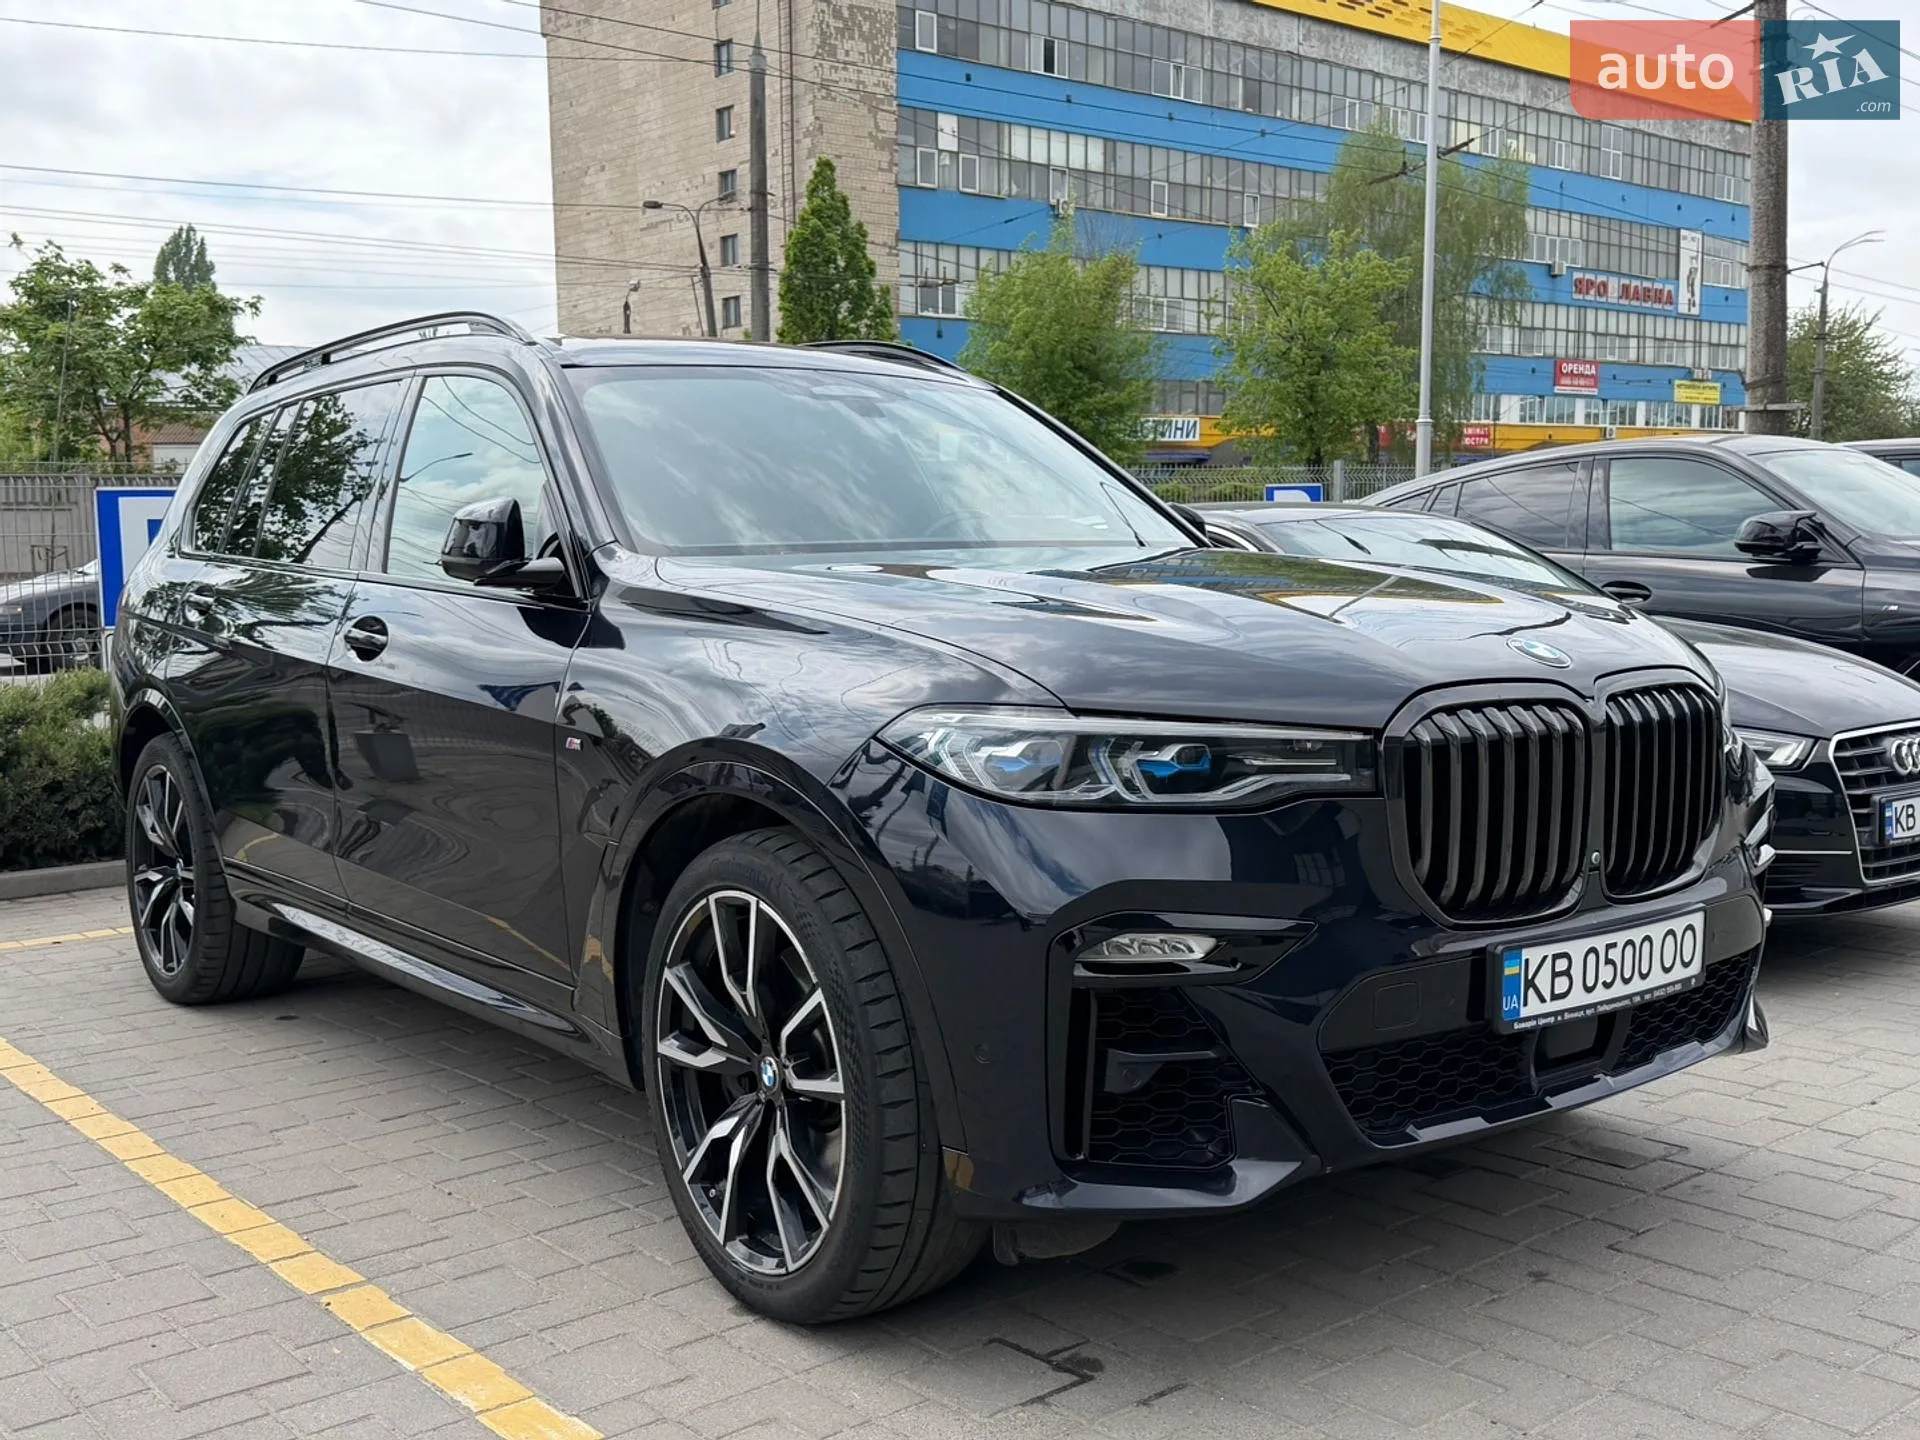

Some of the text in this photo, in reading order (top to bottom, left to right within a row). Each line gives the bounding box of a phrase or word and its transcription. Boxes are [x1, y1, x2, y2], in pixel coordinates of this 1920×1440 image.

[1574, 277, 1674, 306] ЯРОЛАВНА
[1561, 362, 1596, 376] ОРЕНДА
[1895, 804, 1916, 834] KB
[1522, 923, 1697, 1007] KB 0500 OO
[1503, 994, 1518, 1011] UA
